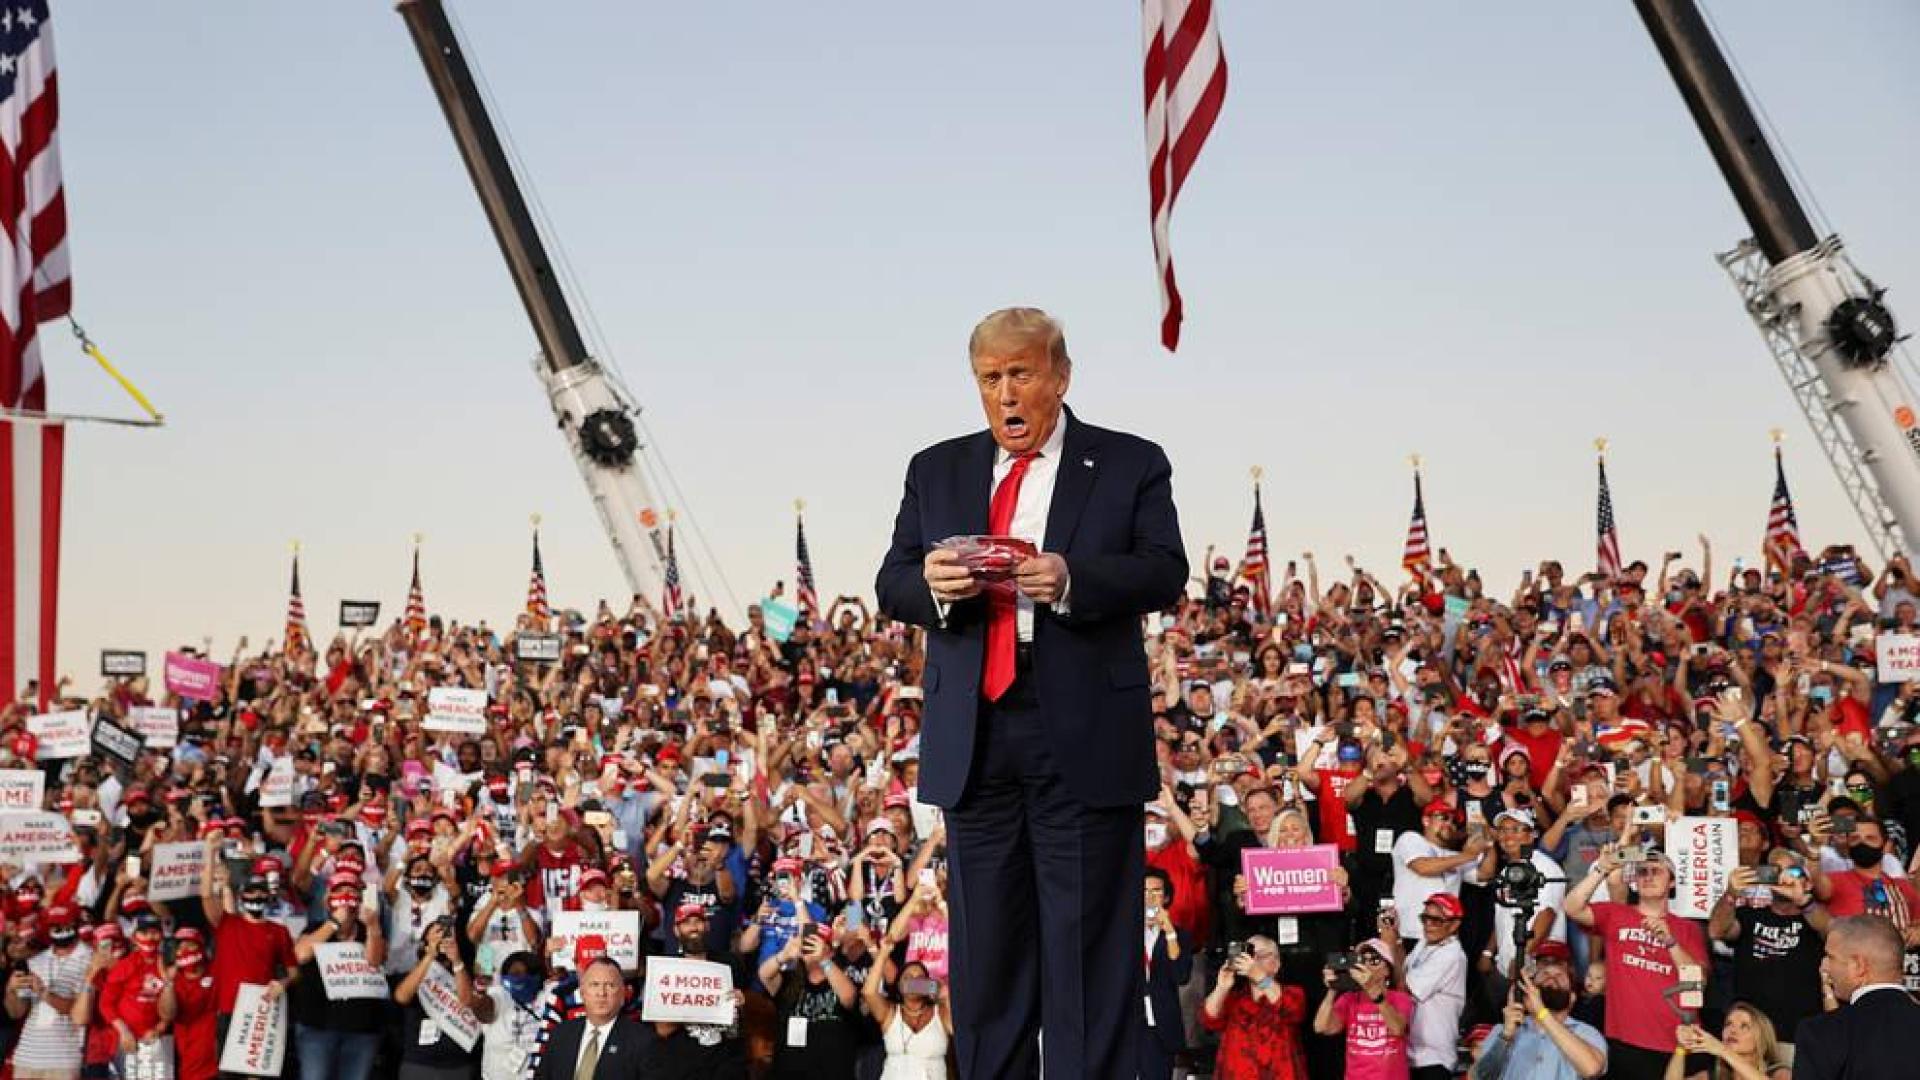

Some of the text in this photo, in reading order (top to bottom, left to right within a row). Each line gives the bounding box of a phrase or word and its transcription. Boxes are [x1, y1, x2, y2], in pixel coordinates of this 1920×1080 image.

[1712, 823, 1723, 866] AGAIN
[1252, 866, 1328, 887] Women
[1678, 848, 1688, 885] MAKE
[1693, 823, 1708, 912] AMERICA
[660, 974, 722, 989] 4 MORE
[661, 992, 721, 1007] YEARS!
